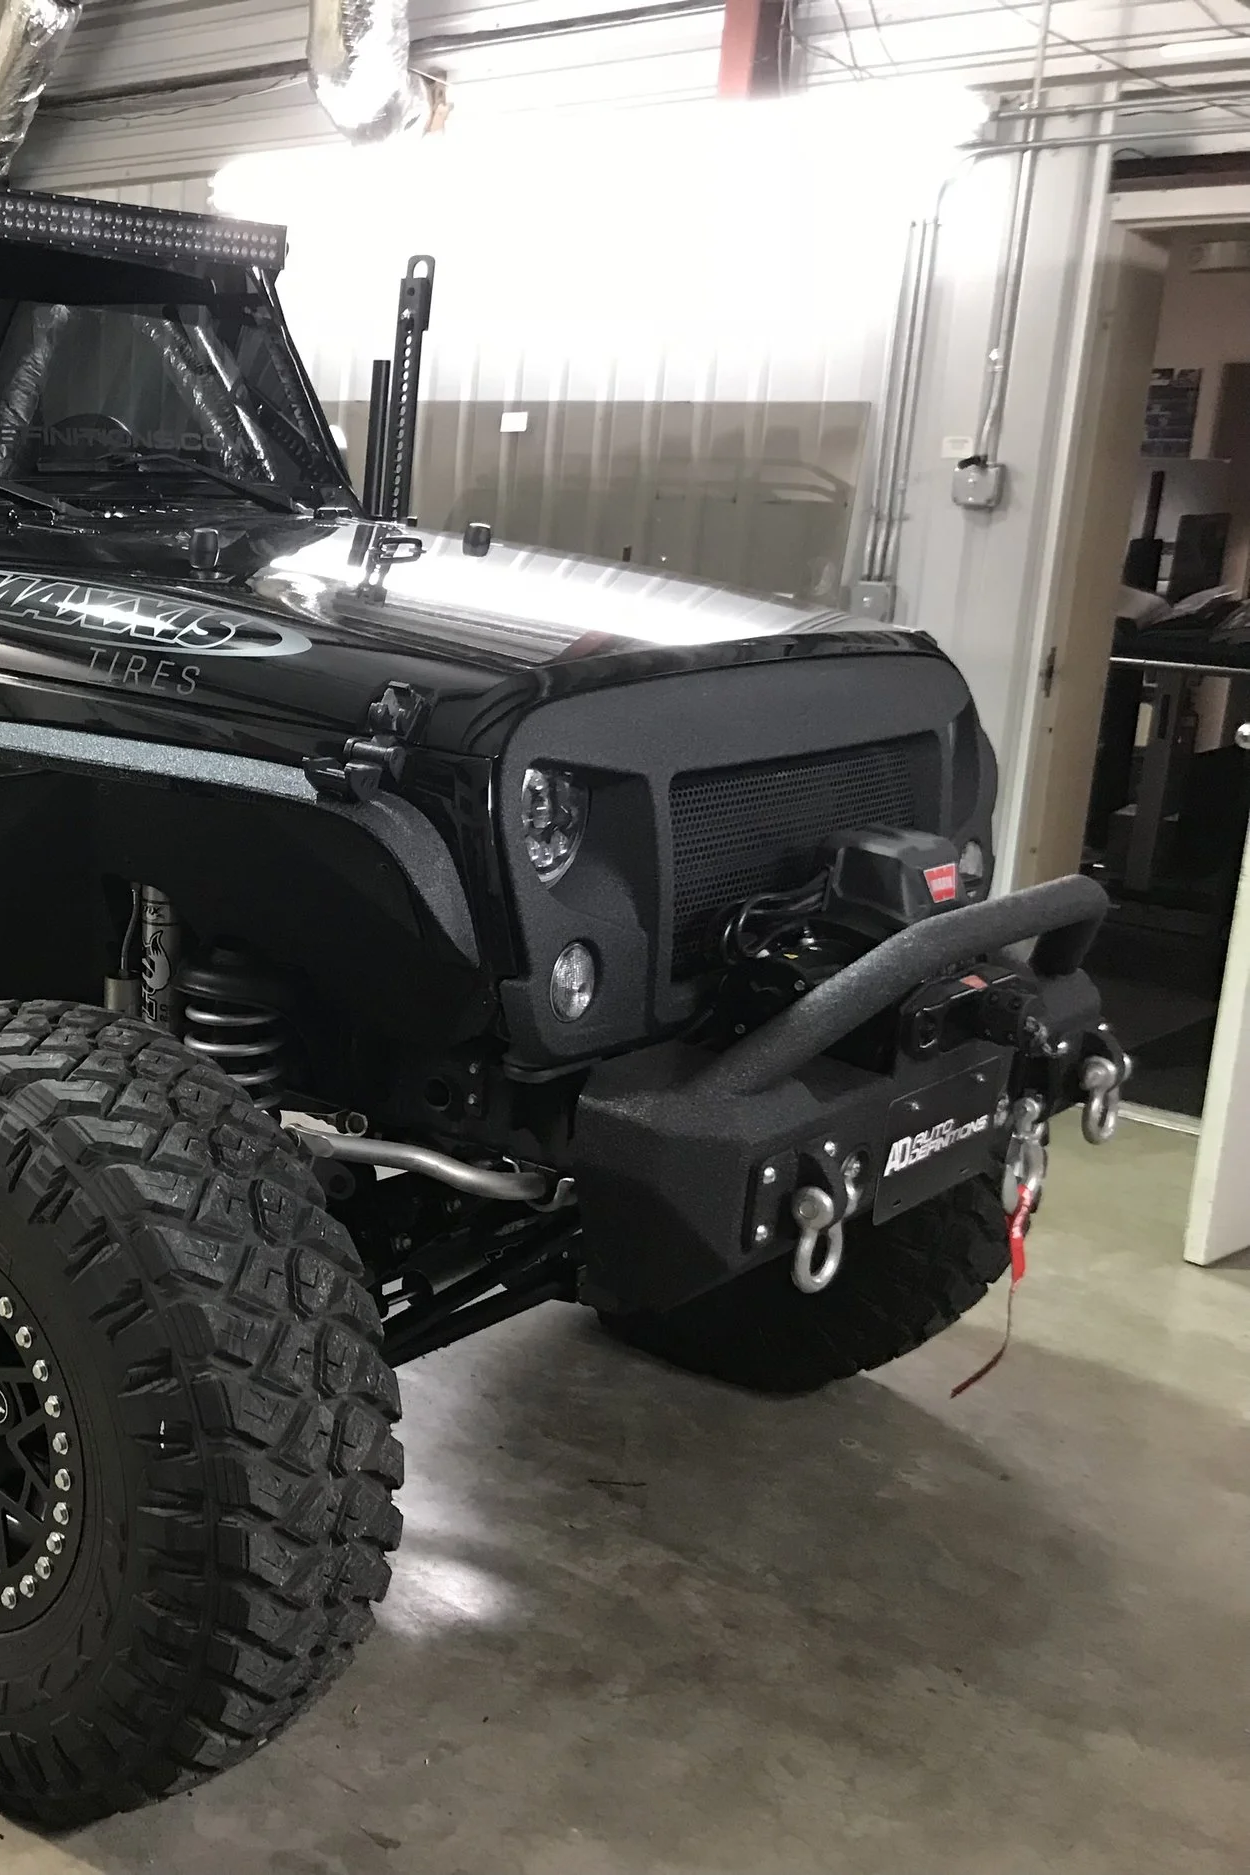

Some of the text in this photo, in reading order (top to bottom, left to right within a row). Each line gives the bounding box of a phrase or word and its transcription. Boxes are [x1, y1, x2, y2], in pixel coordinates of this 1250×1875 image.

[87, 646, 201, 696] TIRES
[908, 1114, 990, 1166] DEFINITIONS
[912, 1118, 955, 1150] AUTO
